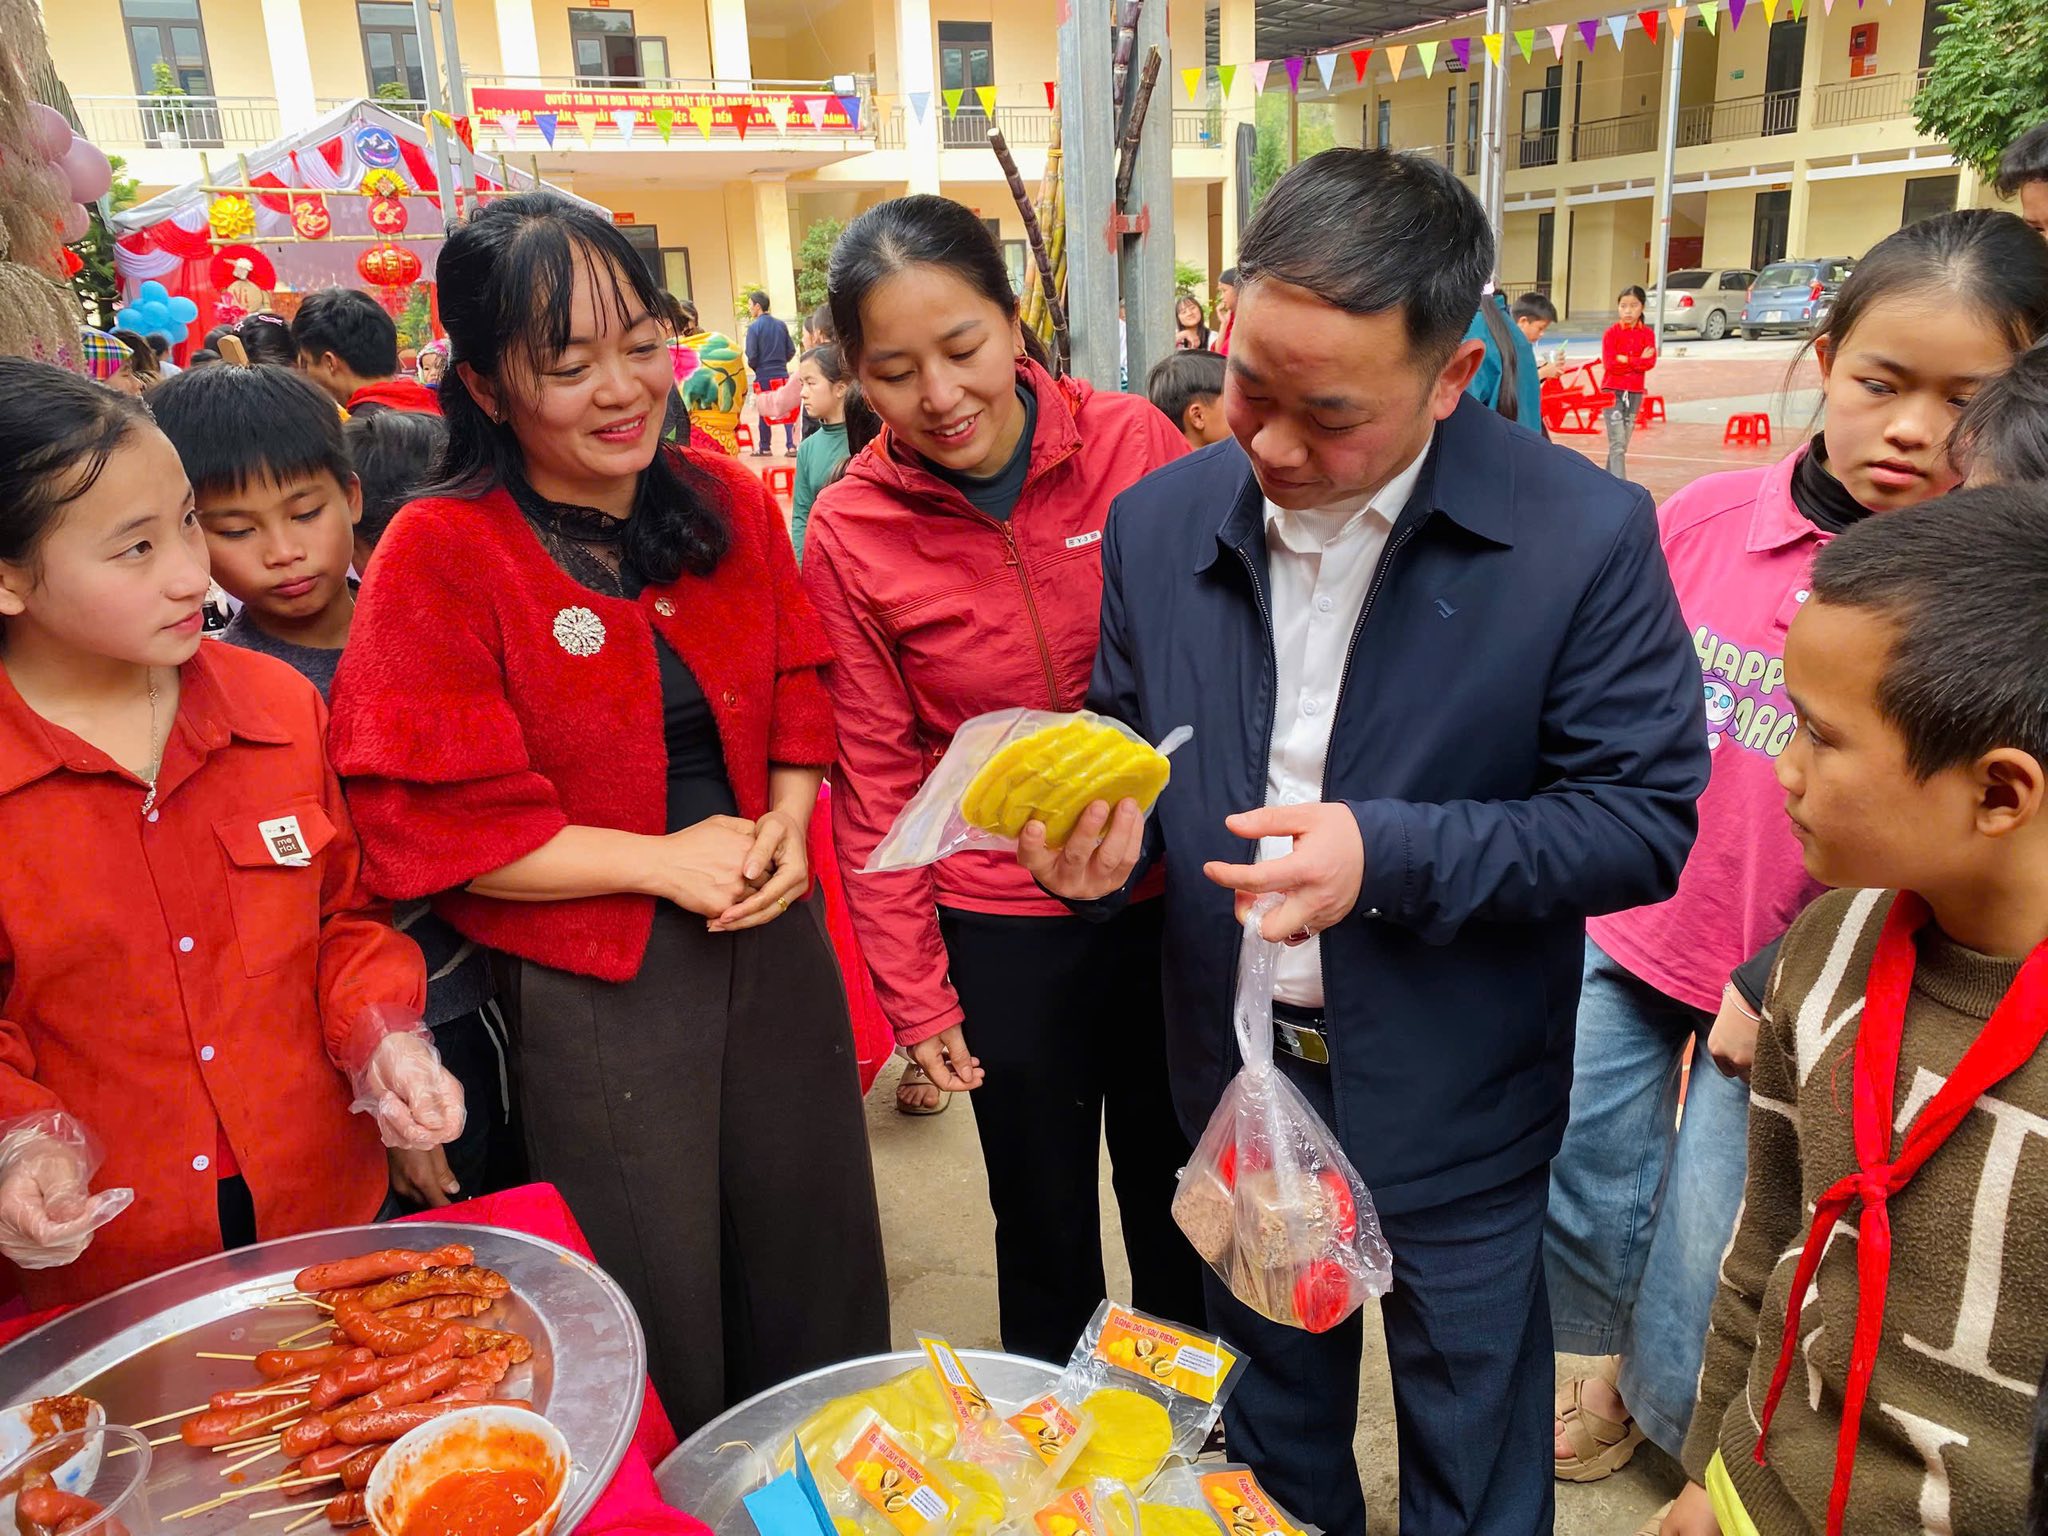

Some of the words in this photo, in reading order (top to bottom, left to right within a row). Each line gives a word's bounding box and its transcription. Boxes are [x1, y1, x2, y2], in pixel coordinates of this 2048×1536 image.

[545, 91, 572, 106] QUYẾT
[573, 93, 593, 106] TÂM
[594, 94, 608, 106] THI
[628, 95, 651, 108] THỰC
[652, 94, 672, 109] HIỆN
